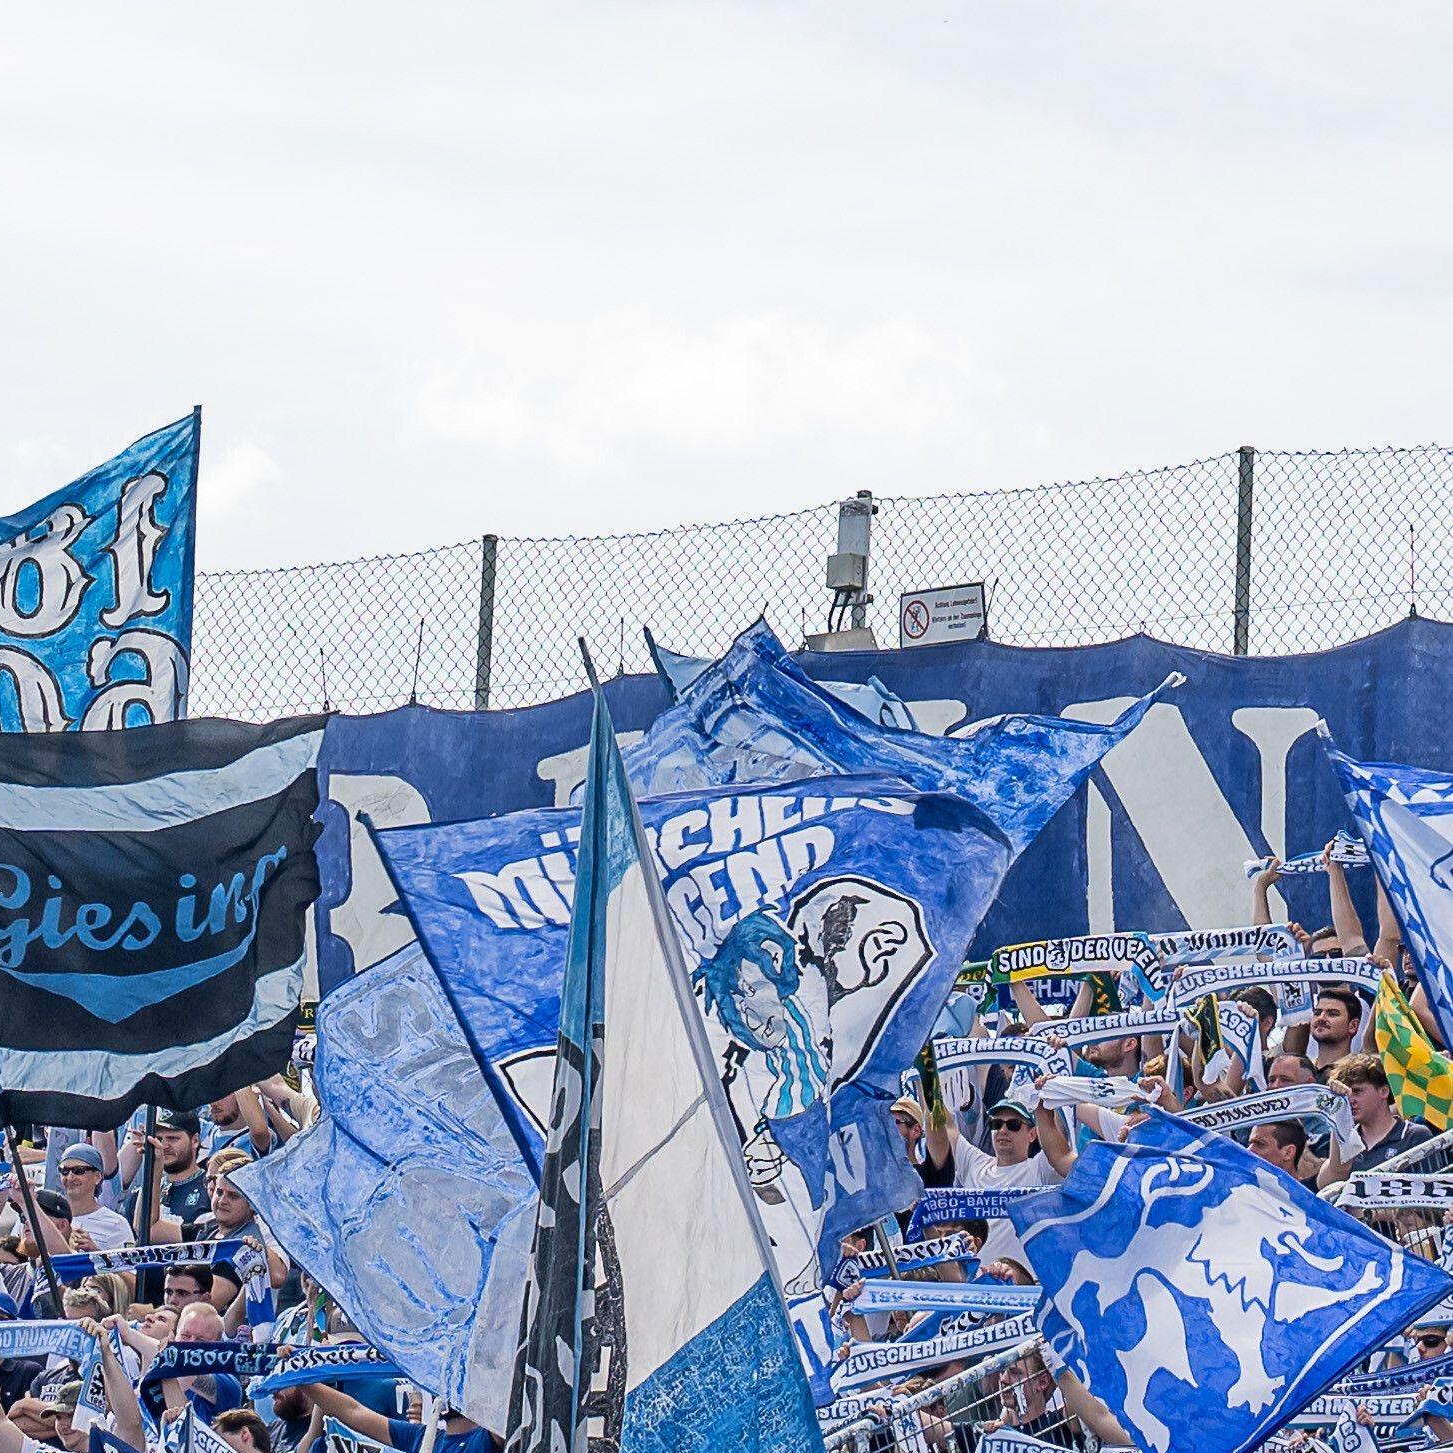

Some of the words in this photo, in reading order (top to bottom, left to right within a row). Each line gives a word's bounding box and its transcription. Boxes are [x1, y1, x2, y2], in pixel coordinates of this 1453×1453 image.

[997, 948, 1048, 972] SIND
[1070, 939, 1108, 961] DER
[1272, 959, 1356, 979] MEISTER
[922, 1208, 969, 1224] MINUTE
[939, 1317, 1019, 1353] MEISTER
